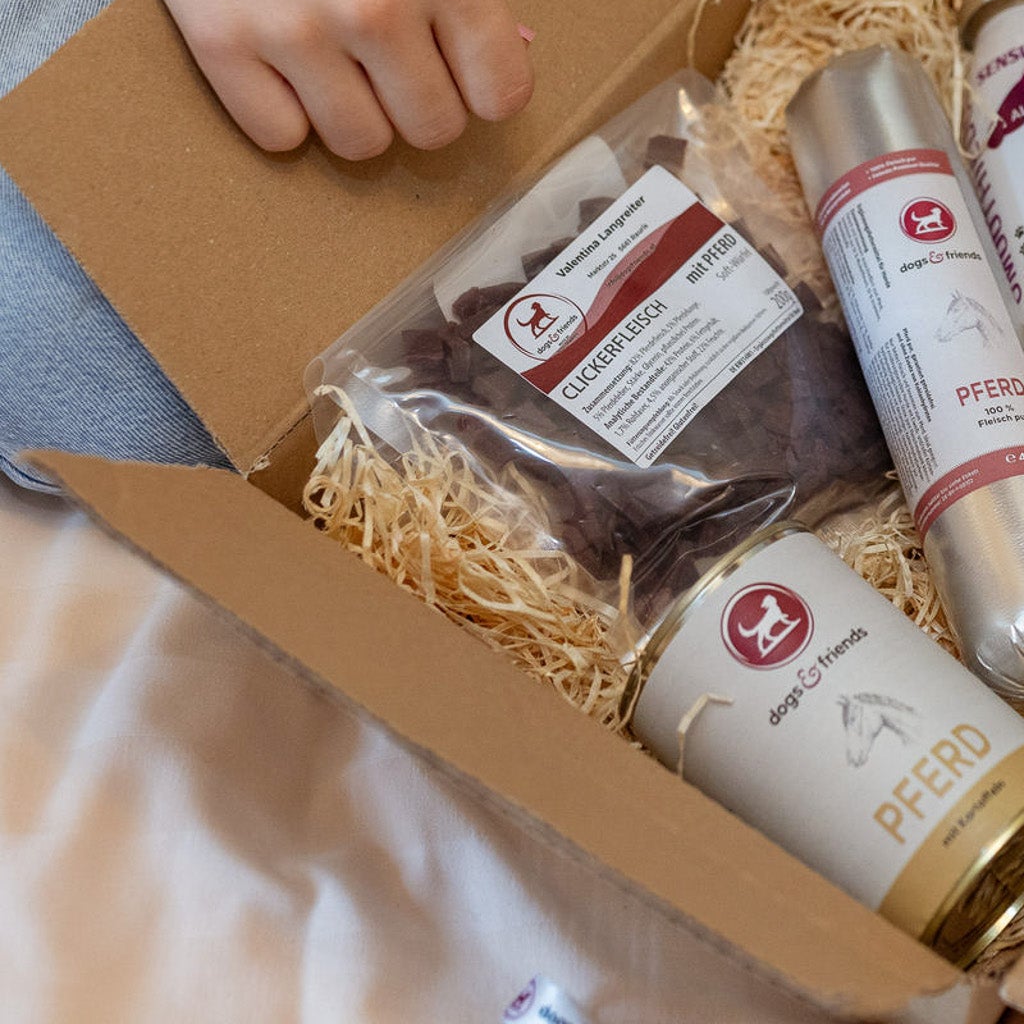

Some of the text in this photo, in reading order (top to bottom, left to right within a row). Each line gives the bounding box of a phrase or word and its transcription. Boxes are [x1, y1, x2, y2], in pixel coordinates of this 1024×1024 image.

[555, 194, 647, 278] Valentina Langreiter
[559, 298, 668, 401] CLICKERFLEISCH
[683, 260, 709, 285] mit
[701, 232, 738, 266] PFERD
[581, 362, 635, 414] Zusammensetzung:
[602, 397, 637, 430] Analytische
[630, 363, 669, 401] Bestandteile:
[645, 387, 663, 404] 4,5%
[984, 404, 1014, 416] 100 %
[978, 415, 1013, 428] Fleisch
[873, 723, 992, 845] PFERD
